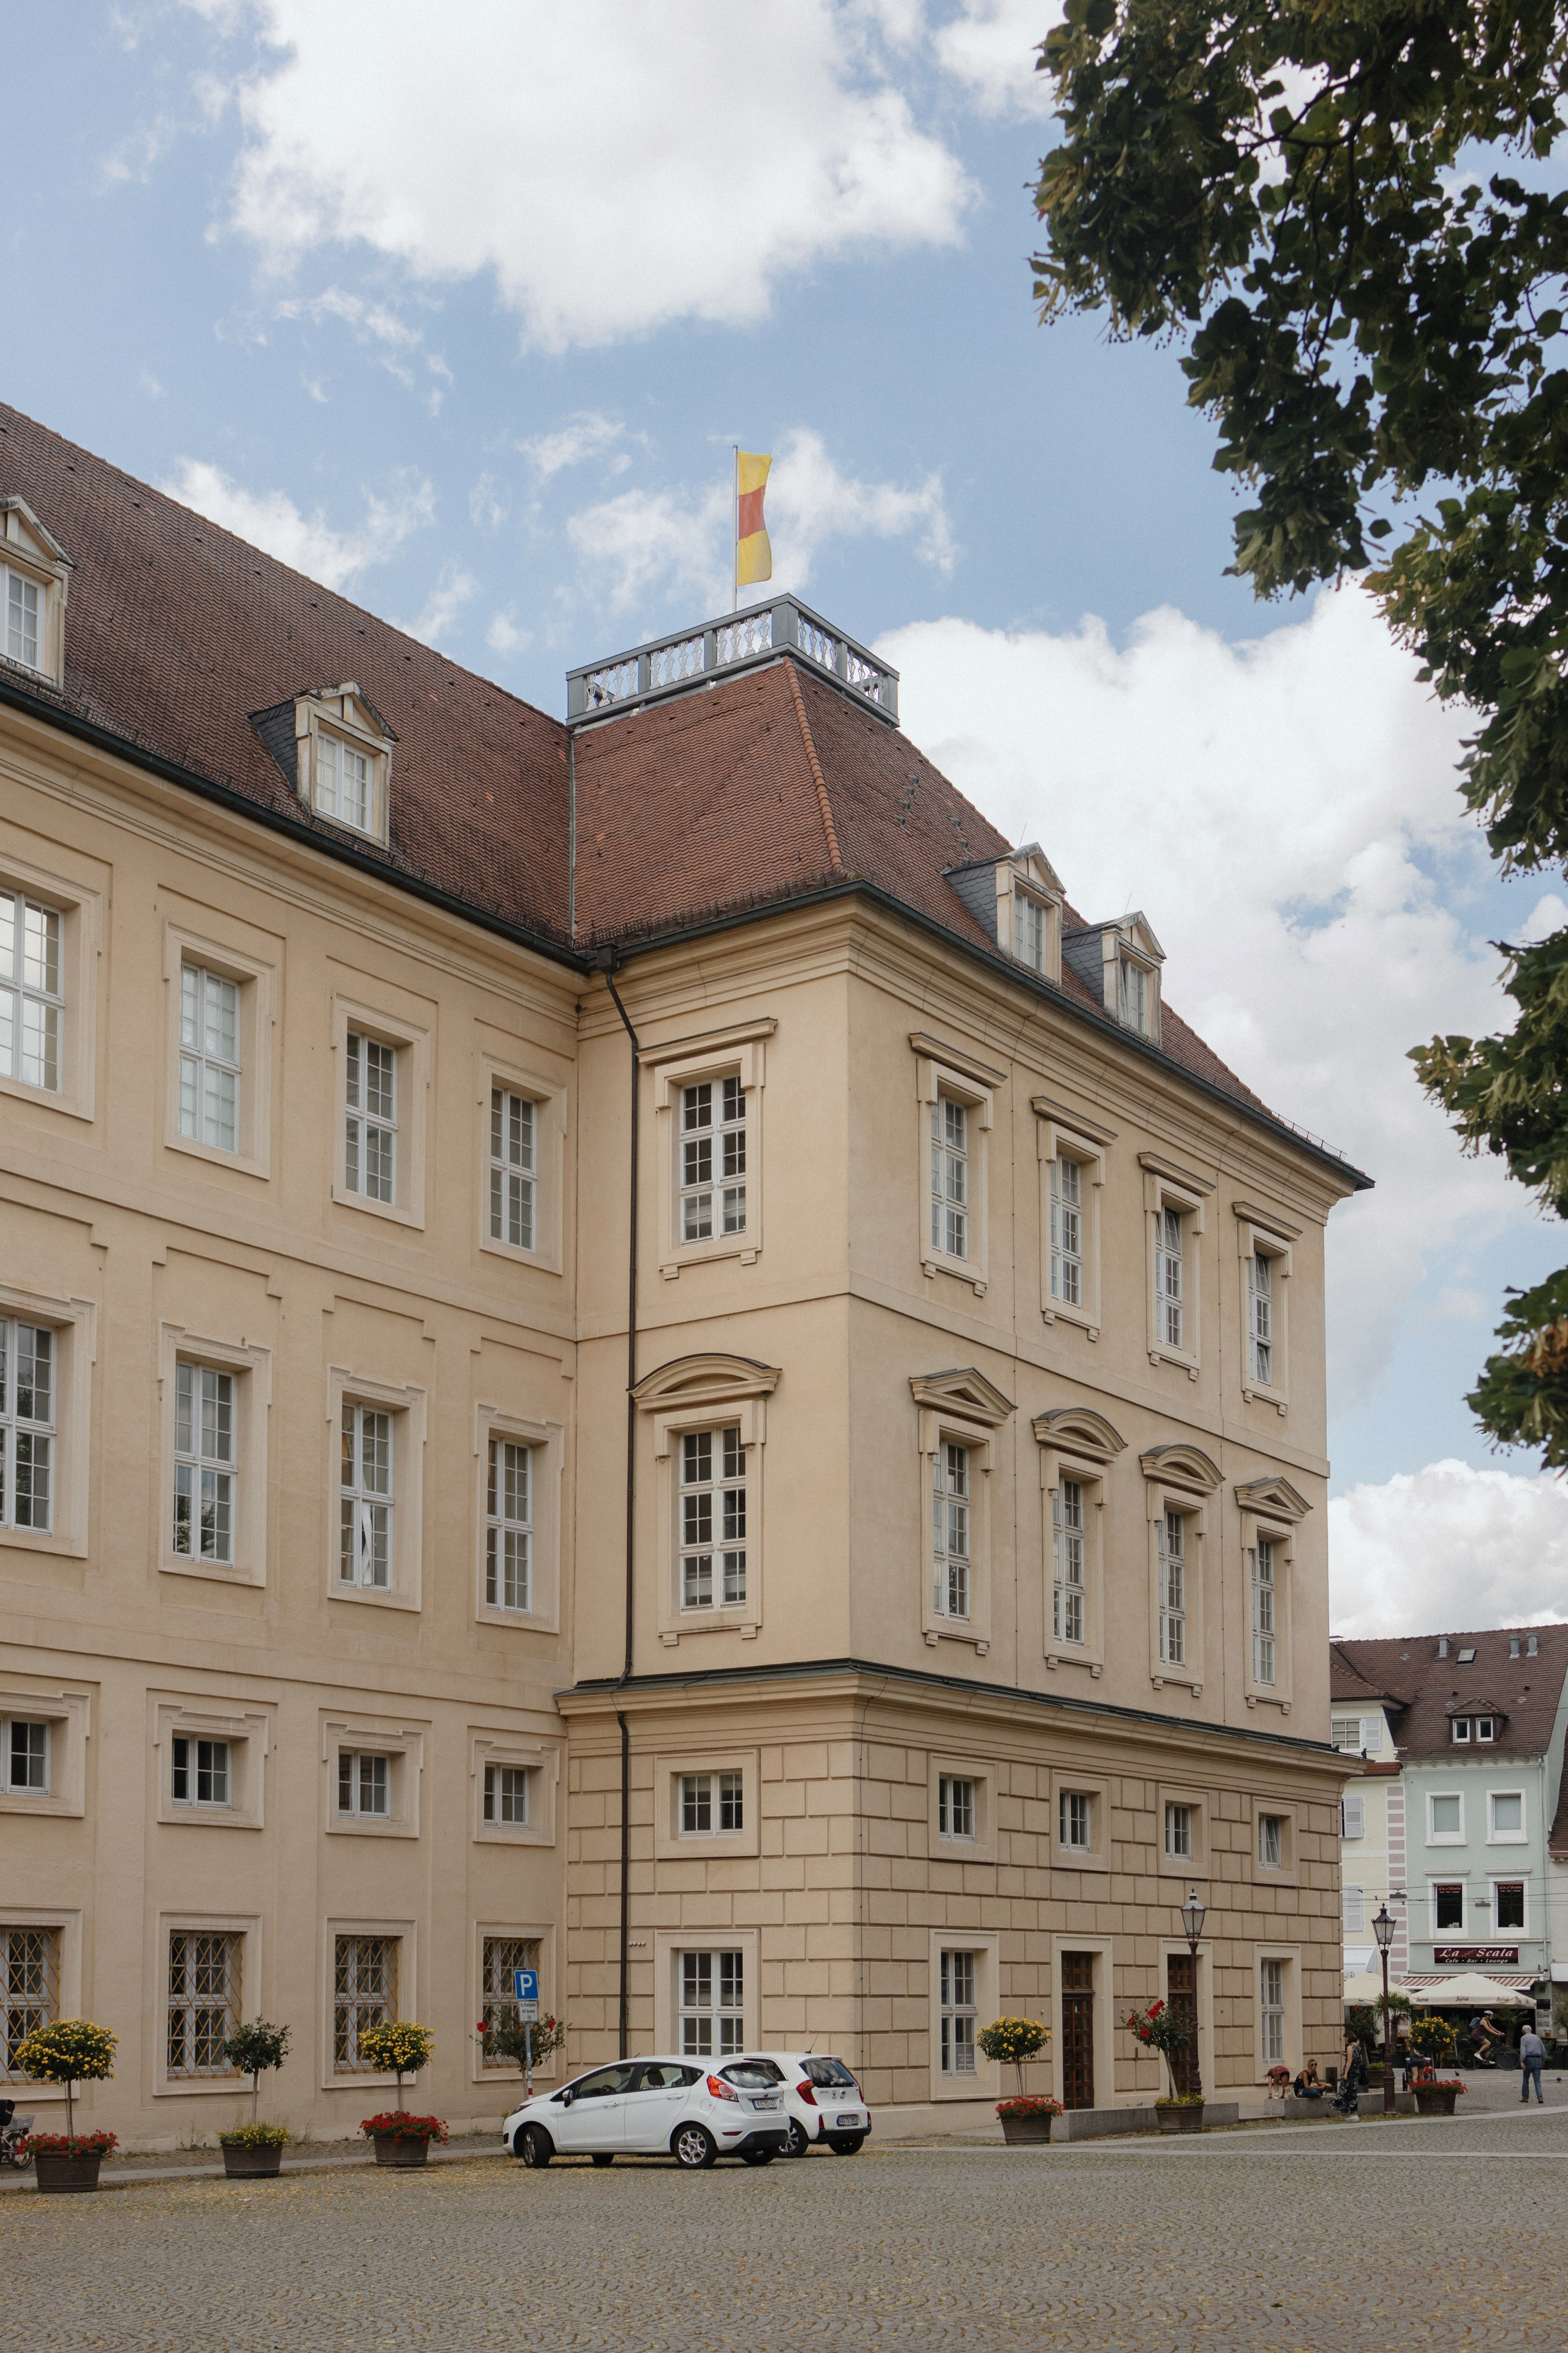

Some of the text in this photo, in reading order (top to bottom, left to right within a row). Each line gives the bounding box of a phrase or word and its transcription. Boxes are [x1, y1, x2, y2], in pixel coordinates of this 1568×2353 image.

[1439, 1948, 1513, 1957] La Scala
[520, 1974, 532, 1995] P
